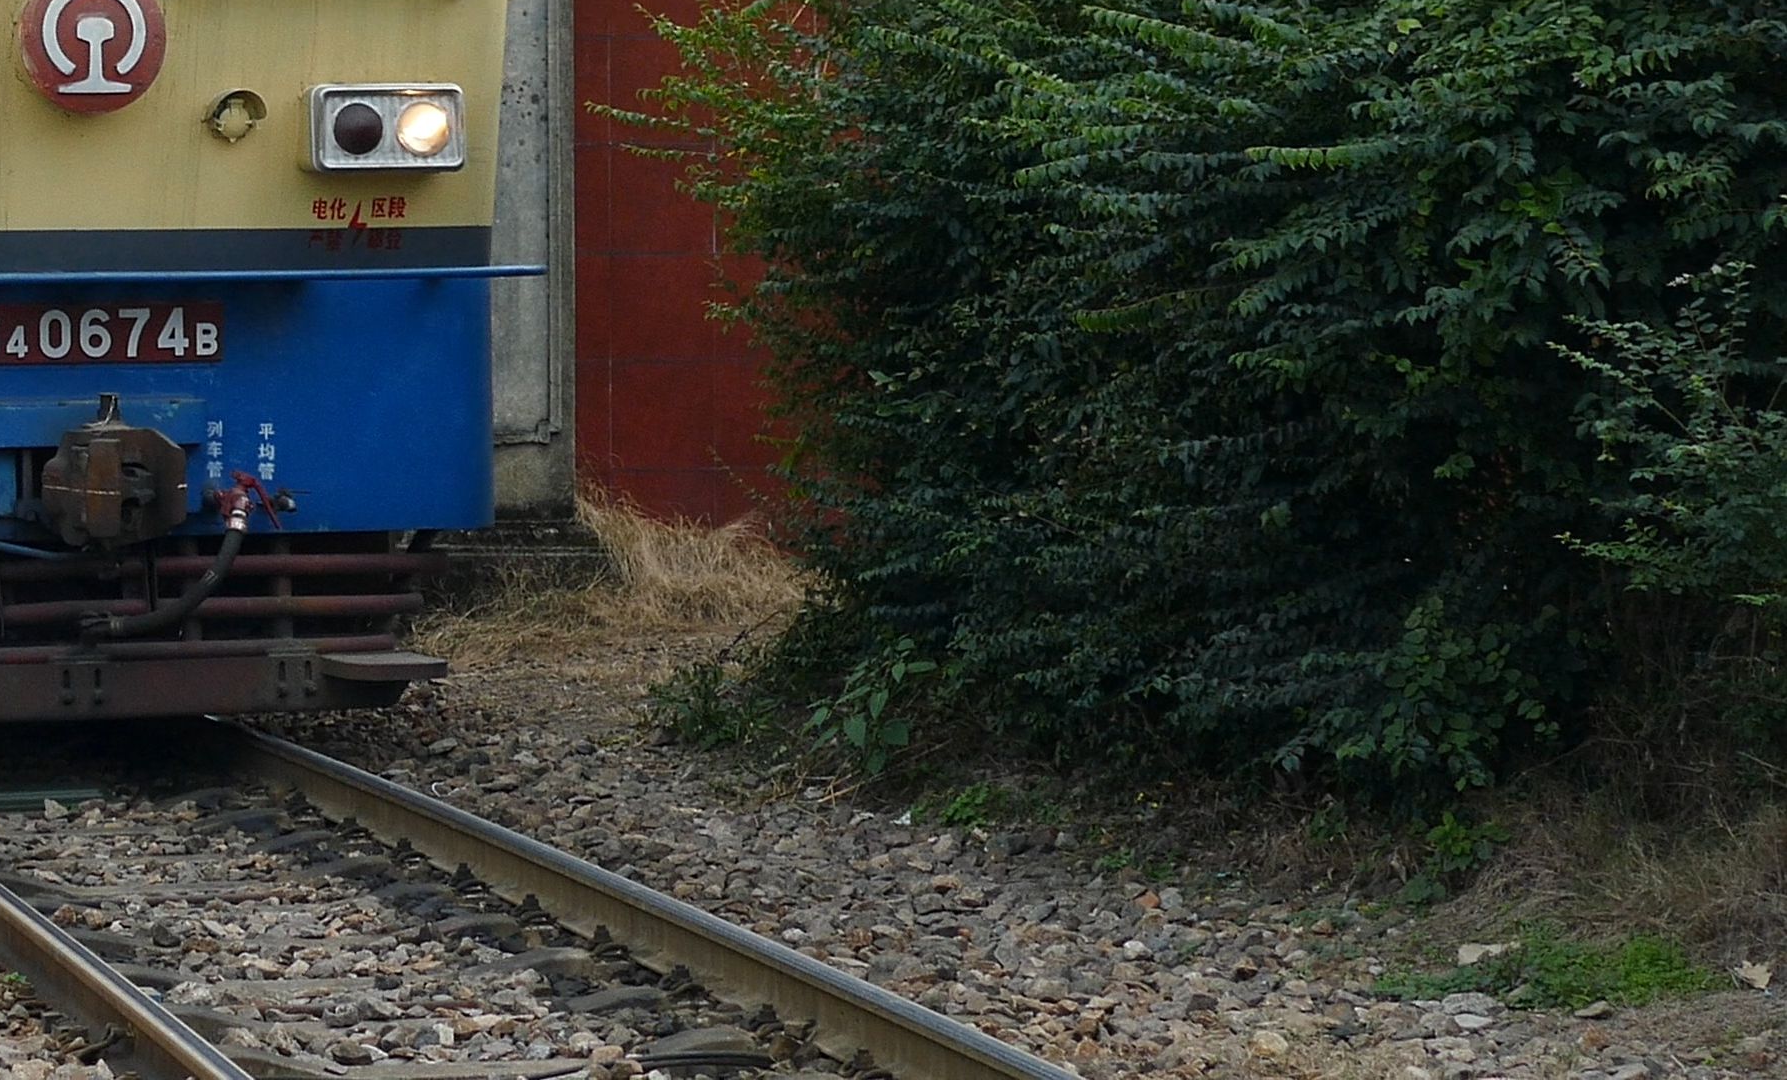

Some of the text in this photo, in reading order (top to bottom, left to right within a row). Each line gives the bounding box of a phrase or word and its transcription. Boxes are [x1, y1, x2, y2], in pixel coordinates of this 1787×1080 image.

[312, 196, 407, 220] 电化 区段
[206, 420, 224, 479] 列车管
[258, 423, 276, 481] 平均管
